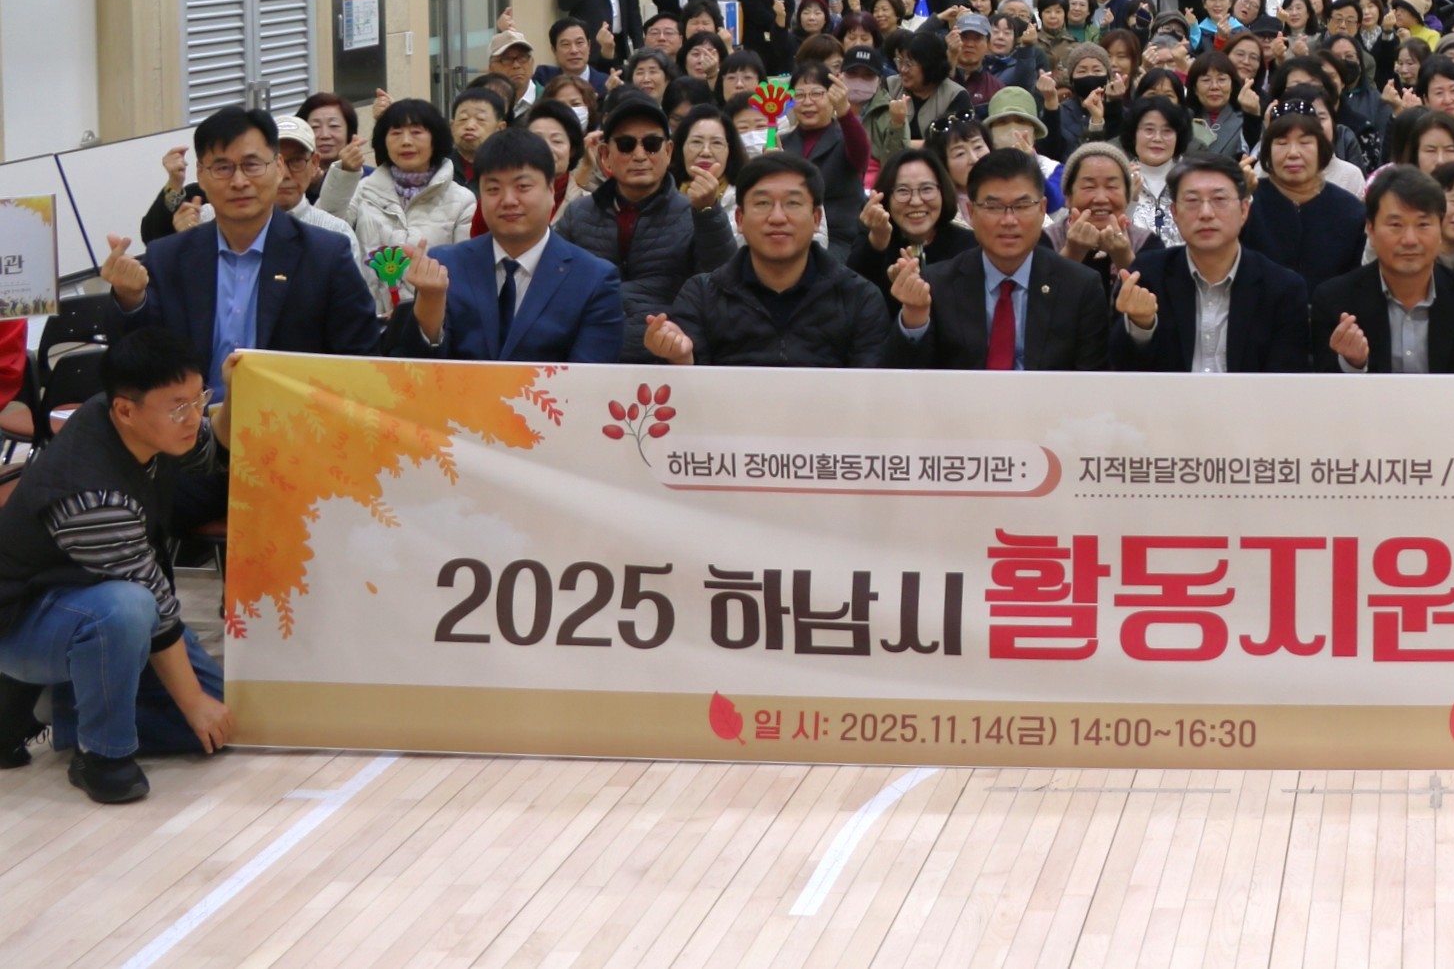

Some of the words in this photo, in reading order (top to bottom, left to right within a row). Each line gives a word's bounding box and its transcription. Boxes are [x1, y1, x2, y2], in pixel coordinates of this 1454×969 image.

[668, 452, 736, 477] 하남시
[745, 454, 910, 481] 장애인활동지원
[1080, 457, 1300, 484] 지적발달장애인협회
[1311, 459, 1432, 485] 하남시지부
[434, 558, 675, 649] 2025
[704, 565, 963, 656] 하남시
[840, 713, 1056, 745] 2025.11.14(금)
[1071, 718, 1256, 748] 14:00~16:30
